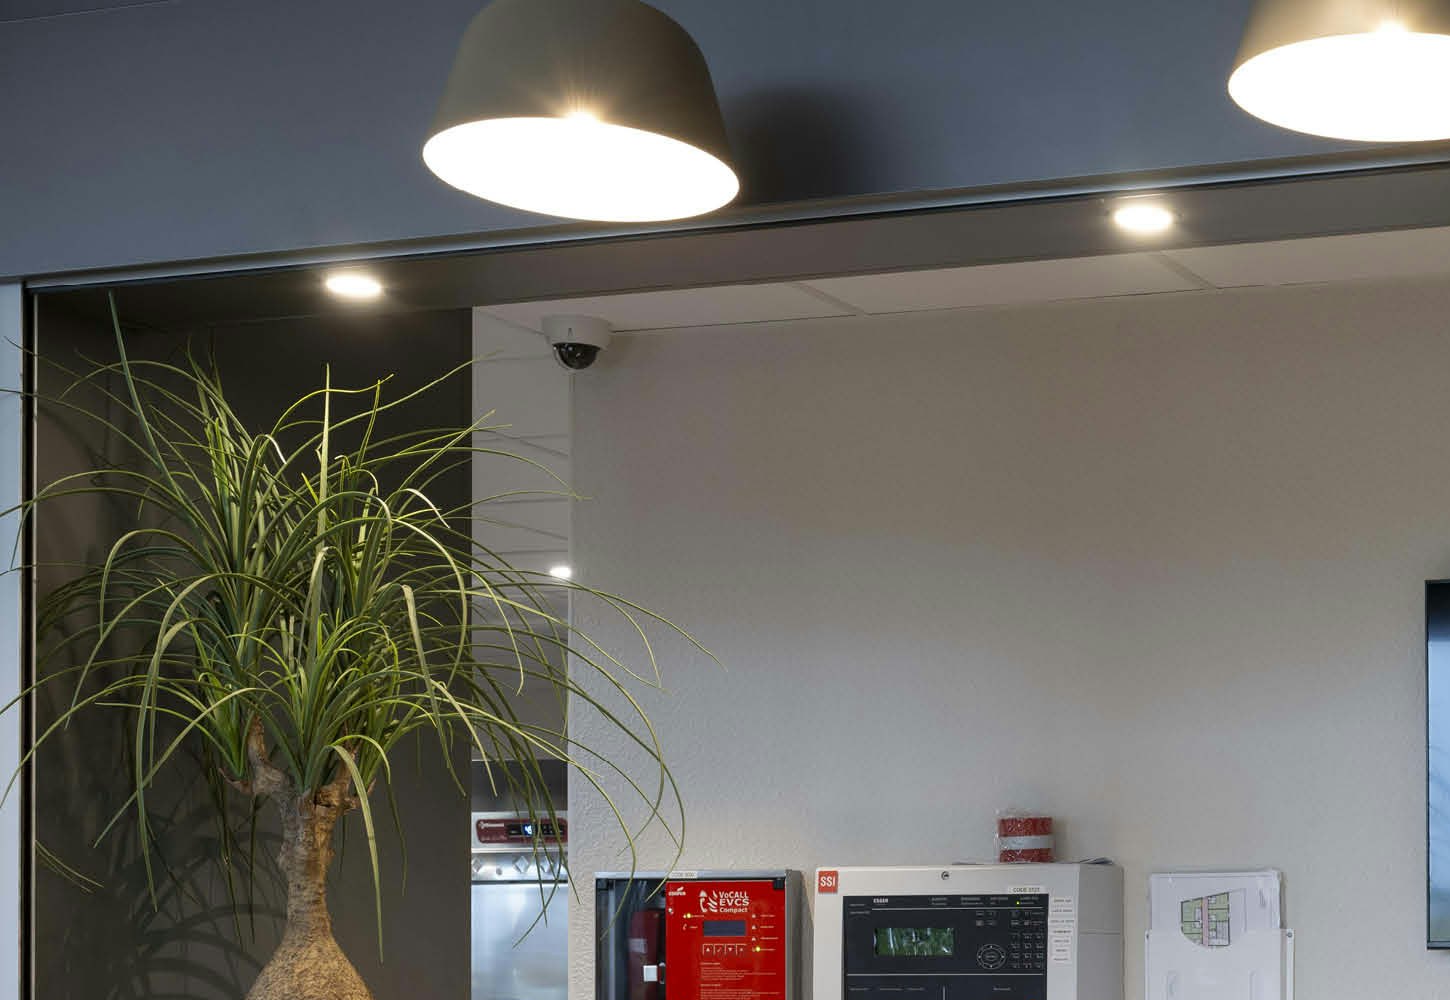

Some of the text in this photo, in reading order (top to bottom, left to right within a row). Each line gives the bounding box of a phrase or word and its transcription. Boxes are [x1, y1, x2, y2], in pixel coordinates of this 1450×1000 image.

[820, 875, 836, 888] SSI
[719, 890, 749, 899] VoCALL
[719, 898, 750, 907] EVCS
